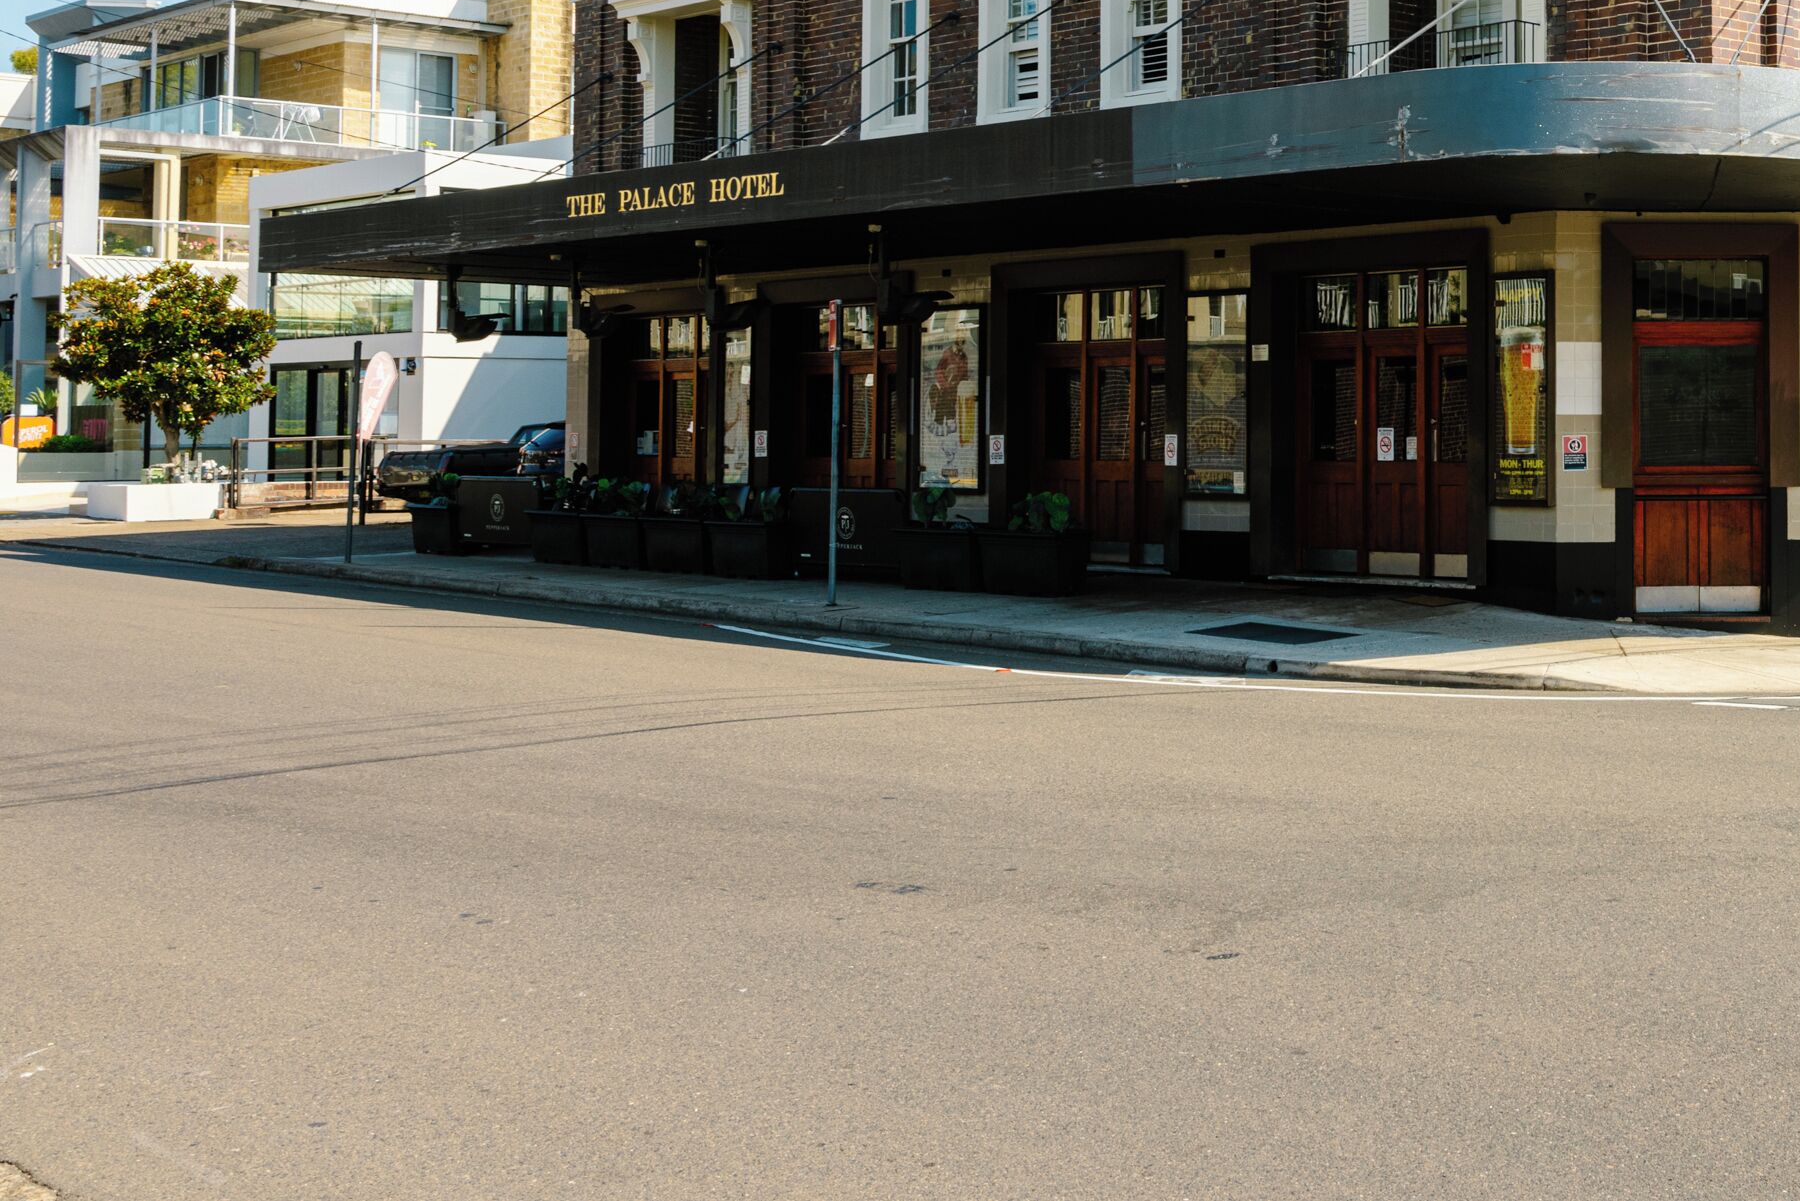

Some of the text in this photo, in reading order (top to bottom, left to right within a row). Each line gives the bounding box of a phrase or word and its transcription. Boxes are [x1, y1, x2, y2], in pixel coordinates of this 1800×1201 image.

[566, 172, 785, 218] THE PALACE HOTEL
[13, 425, 49, 438] PEROL
